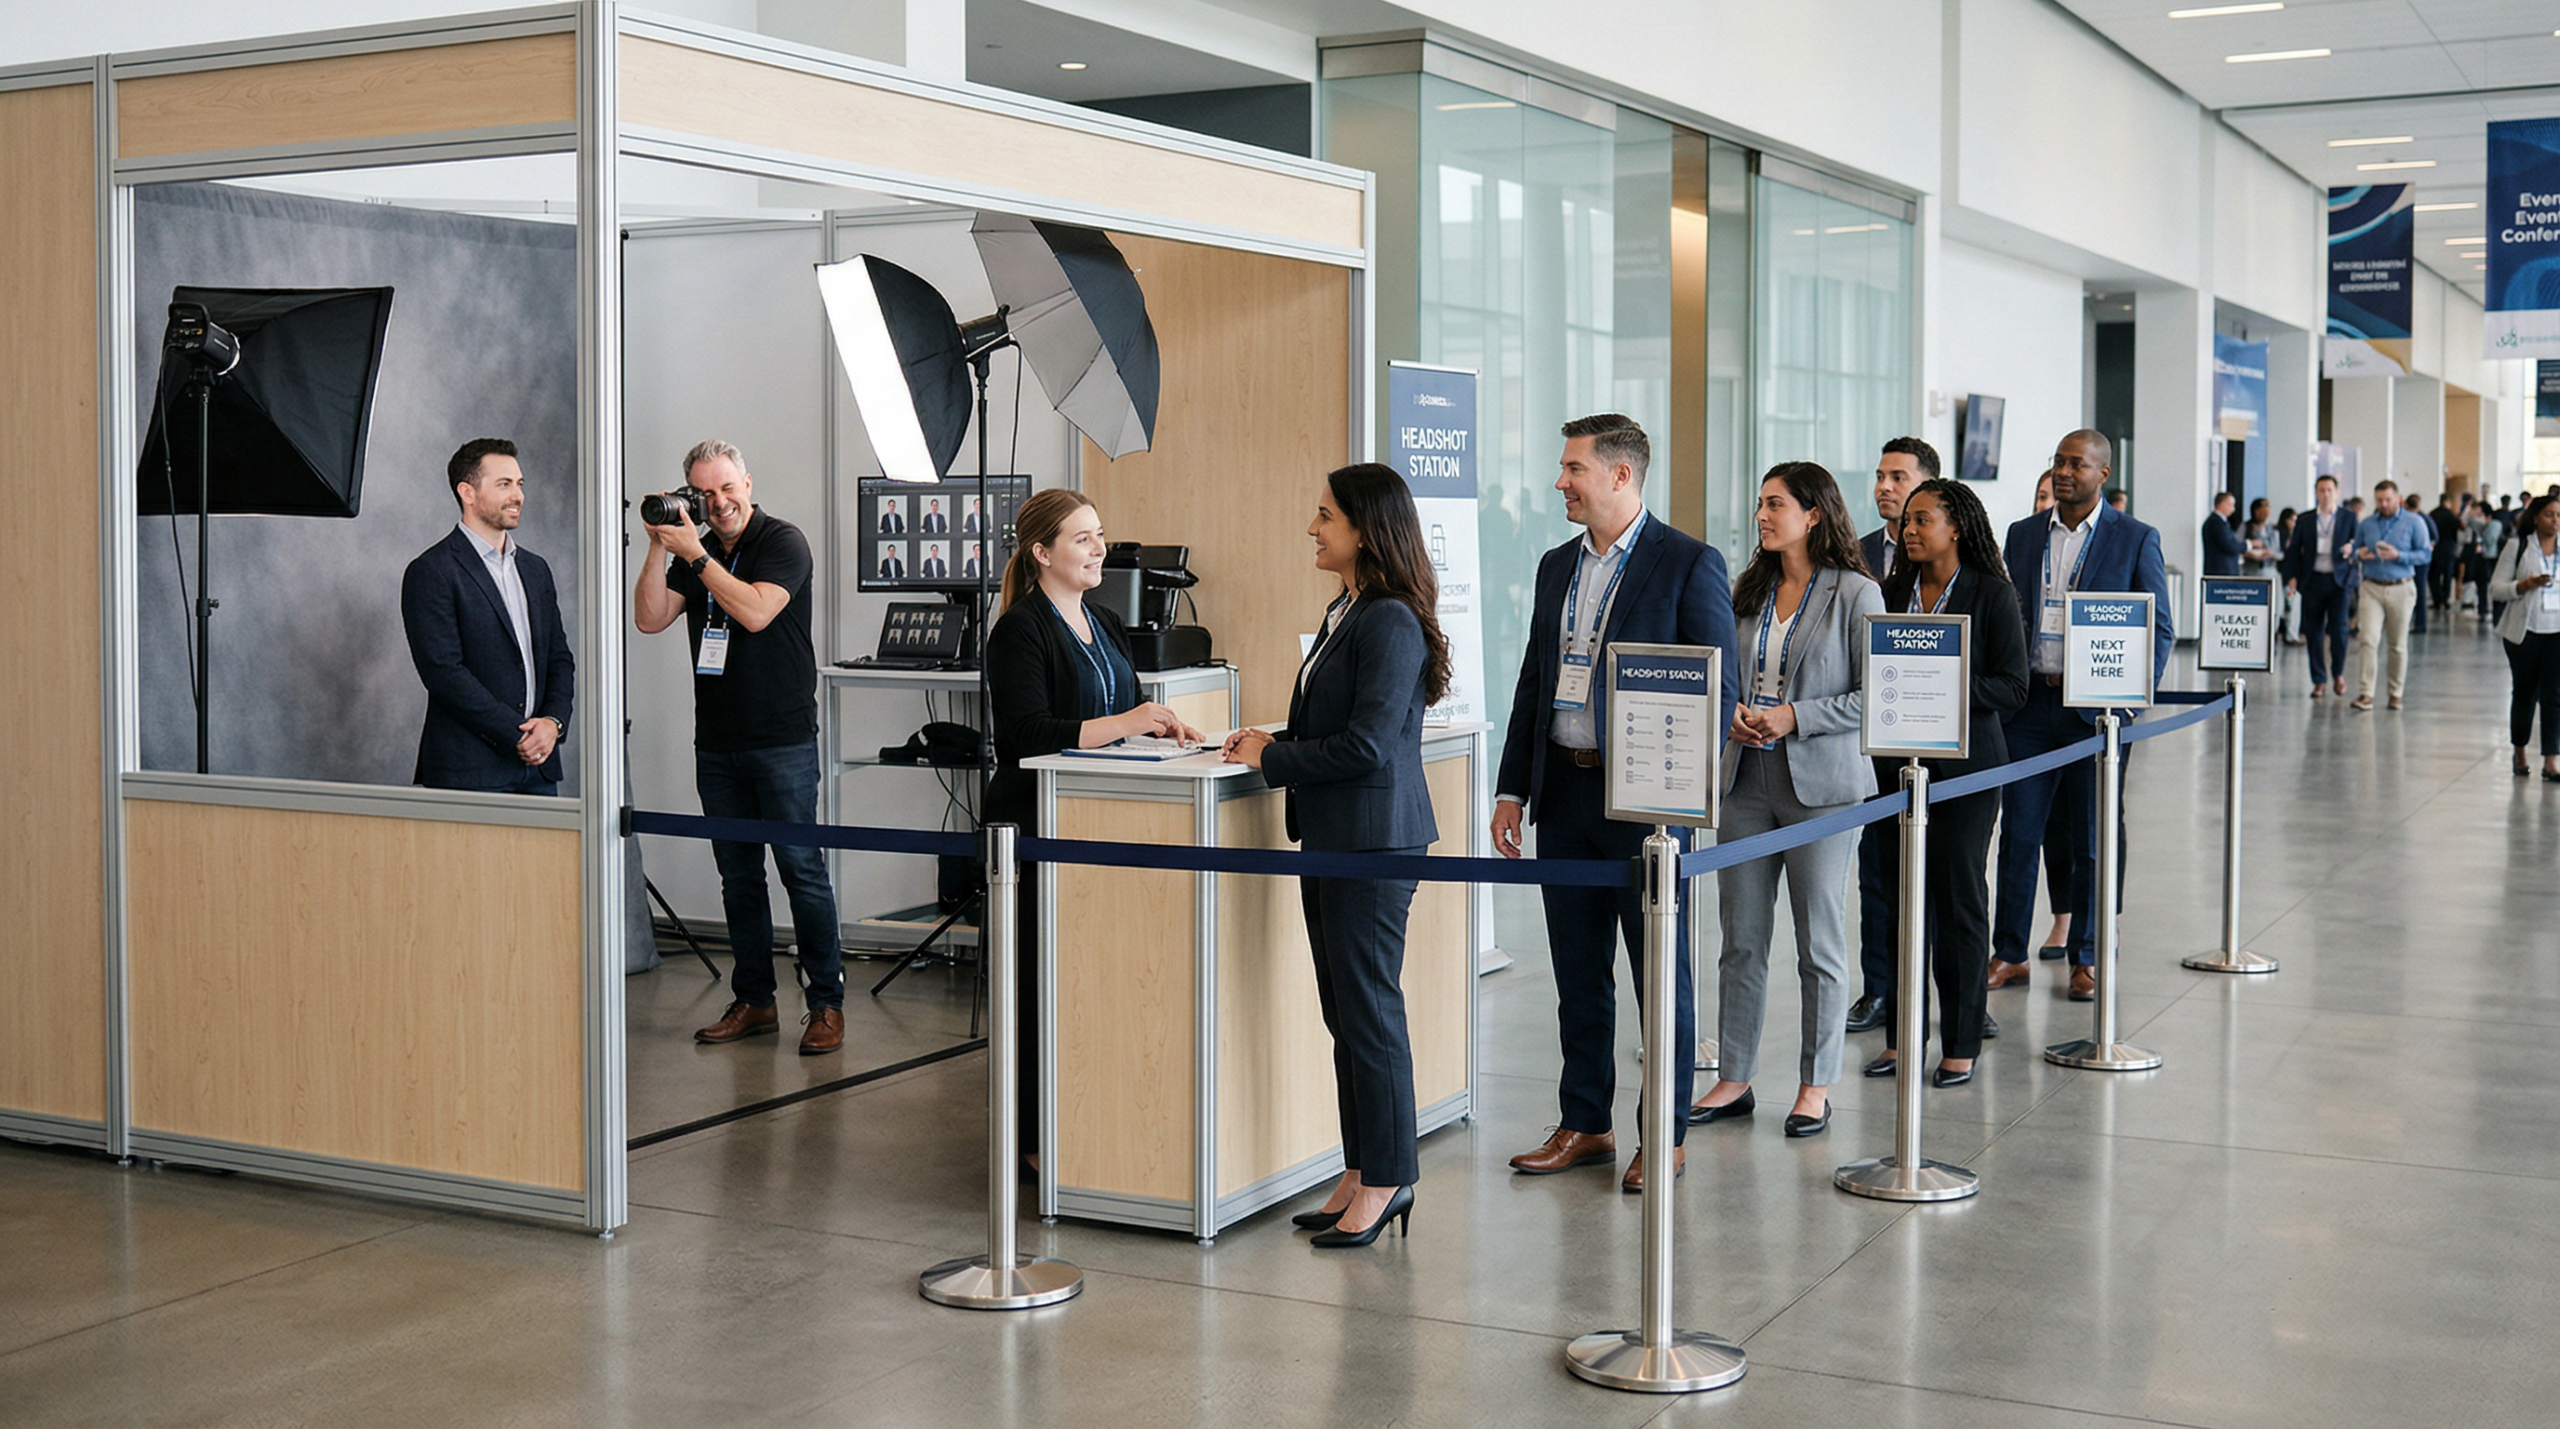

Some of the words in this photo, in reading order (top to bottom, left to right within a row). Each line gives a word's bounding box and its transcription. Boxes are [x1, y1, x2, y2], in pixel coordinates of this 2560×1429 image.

[2515, 210, 2560, 225] Even
[1401, 427, 1468, 451] HEADSHOT
[1409, 455, 1460, 478] STATION
[2214, 614, 2258, 626] PLEASE
[1886, 628, 1946, 640] HEADSHOT
[2220, 627, 2252, 637] WAIT
[1893, 639, 1938, 650] STATION
[2090, 640, 2126, 650] NEXT
[2220, 639, 2251, 649] HERE
[2091, 653, 2125, 664] WAIT
[1621, 667, 1668, 679] HEADSHOT
[2090, 667, 2124, 677] HERE
